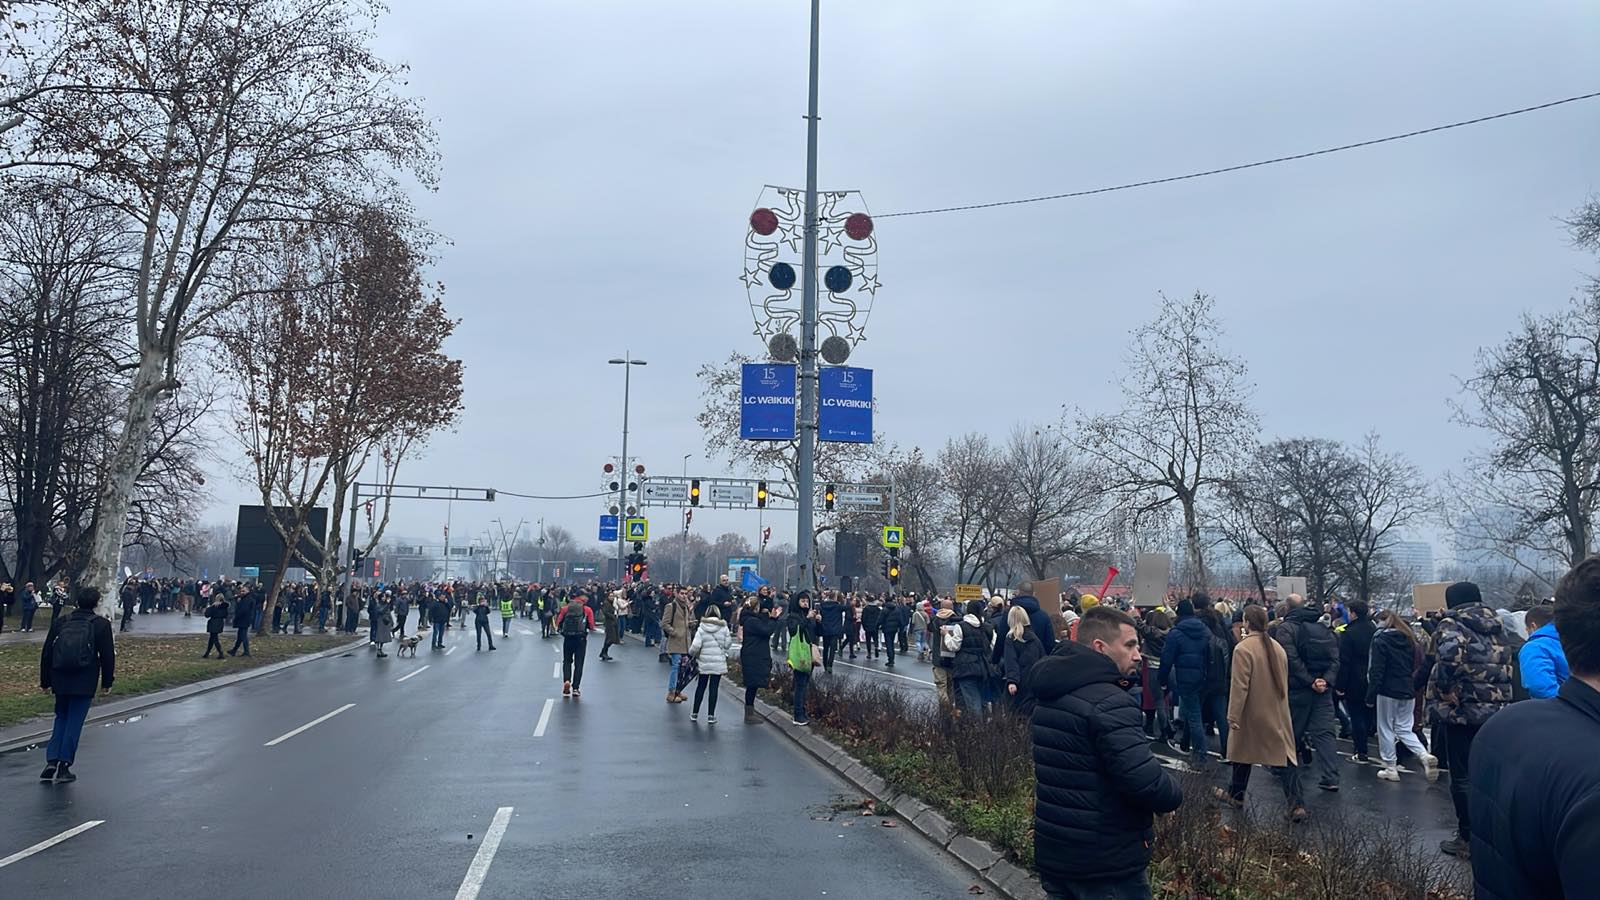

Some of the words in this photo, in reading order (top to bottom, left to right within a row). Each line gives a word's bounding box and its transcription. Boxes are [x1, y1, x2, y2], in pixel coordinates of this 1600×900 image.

[763, 368, 776, 379] 15
[842, 371, 855, 383] 15
[744, 396, 757, 404] LC
[822, 398, 836, 407] LC
